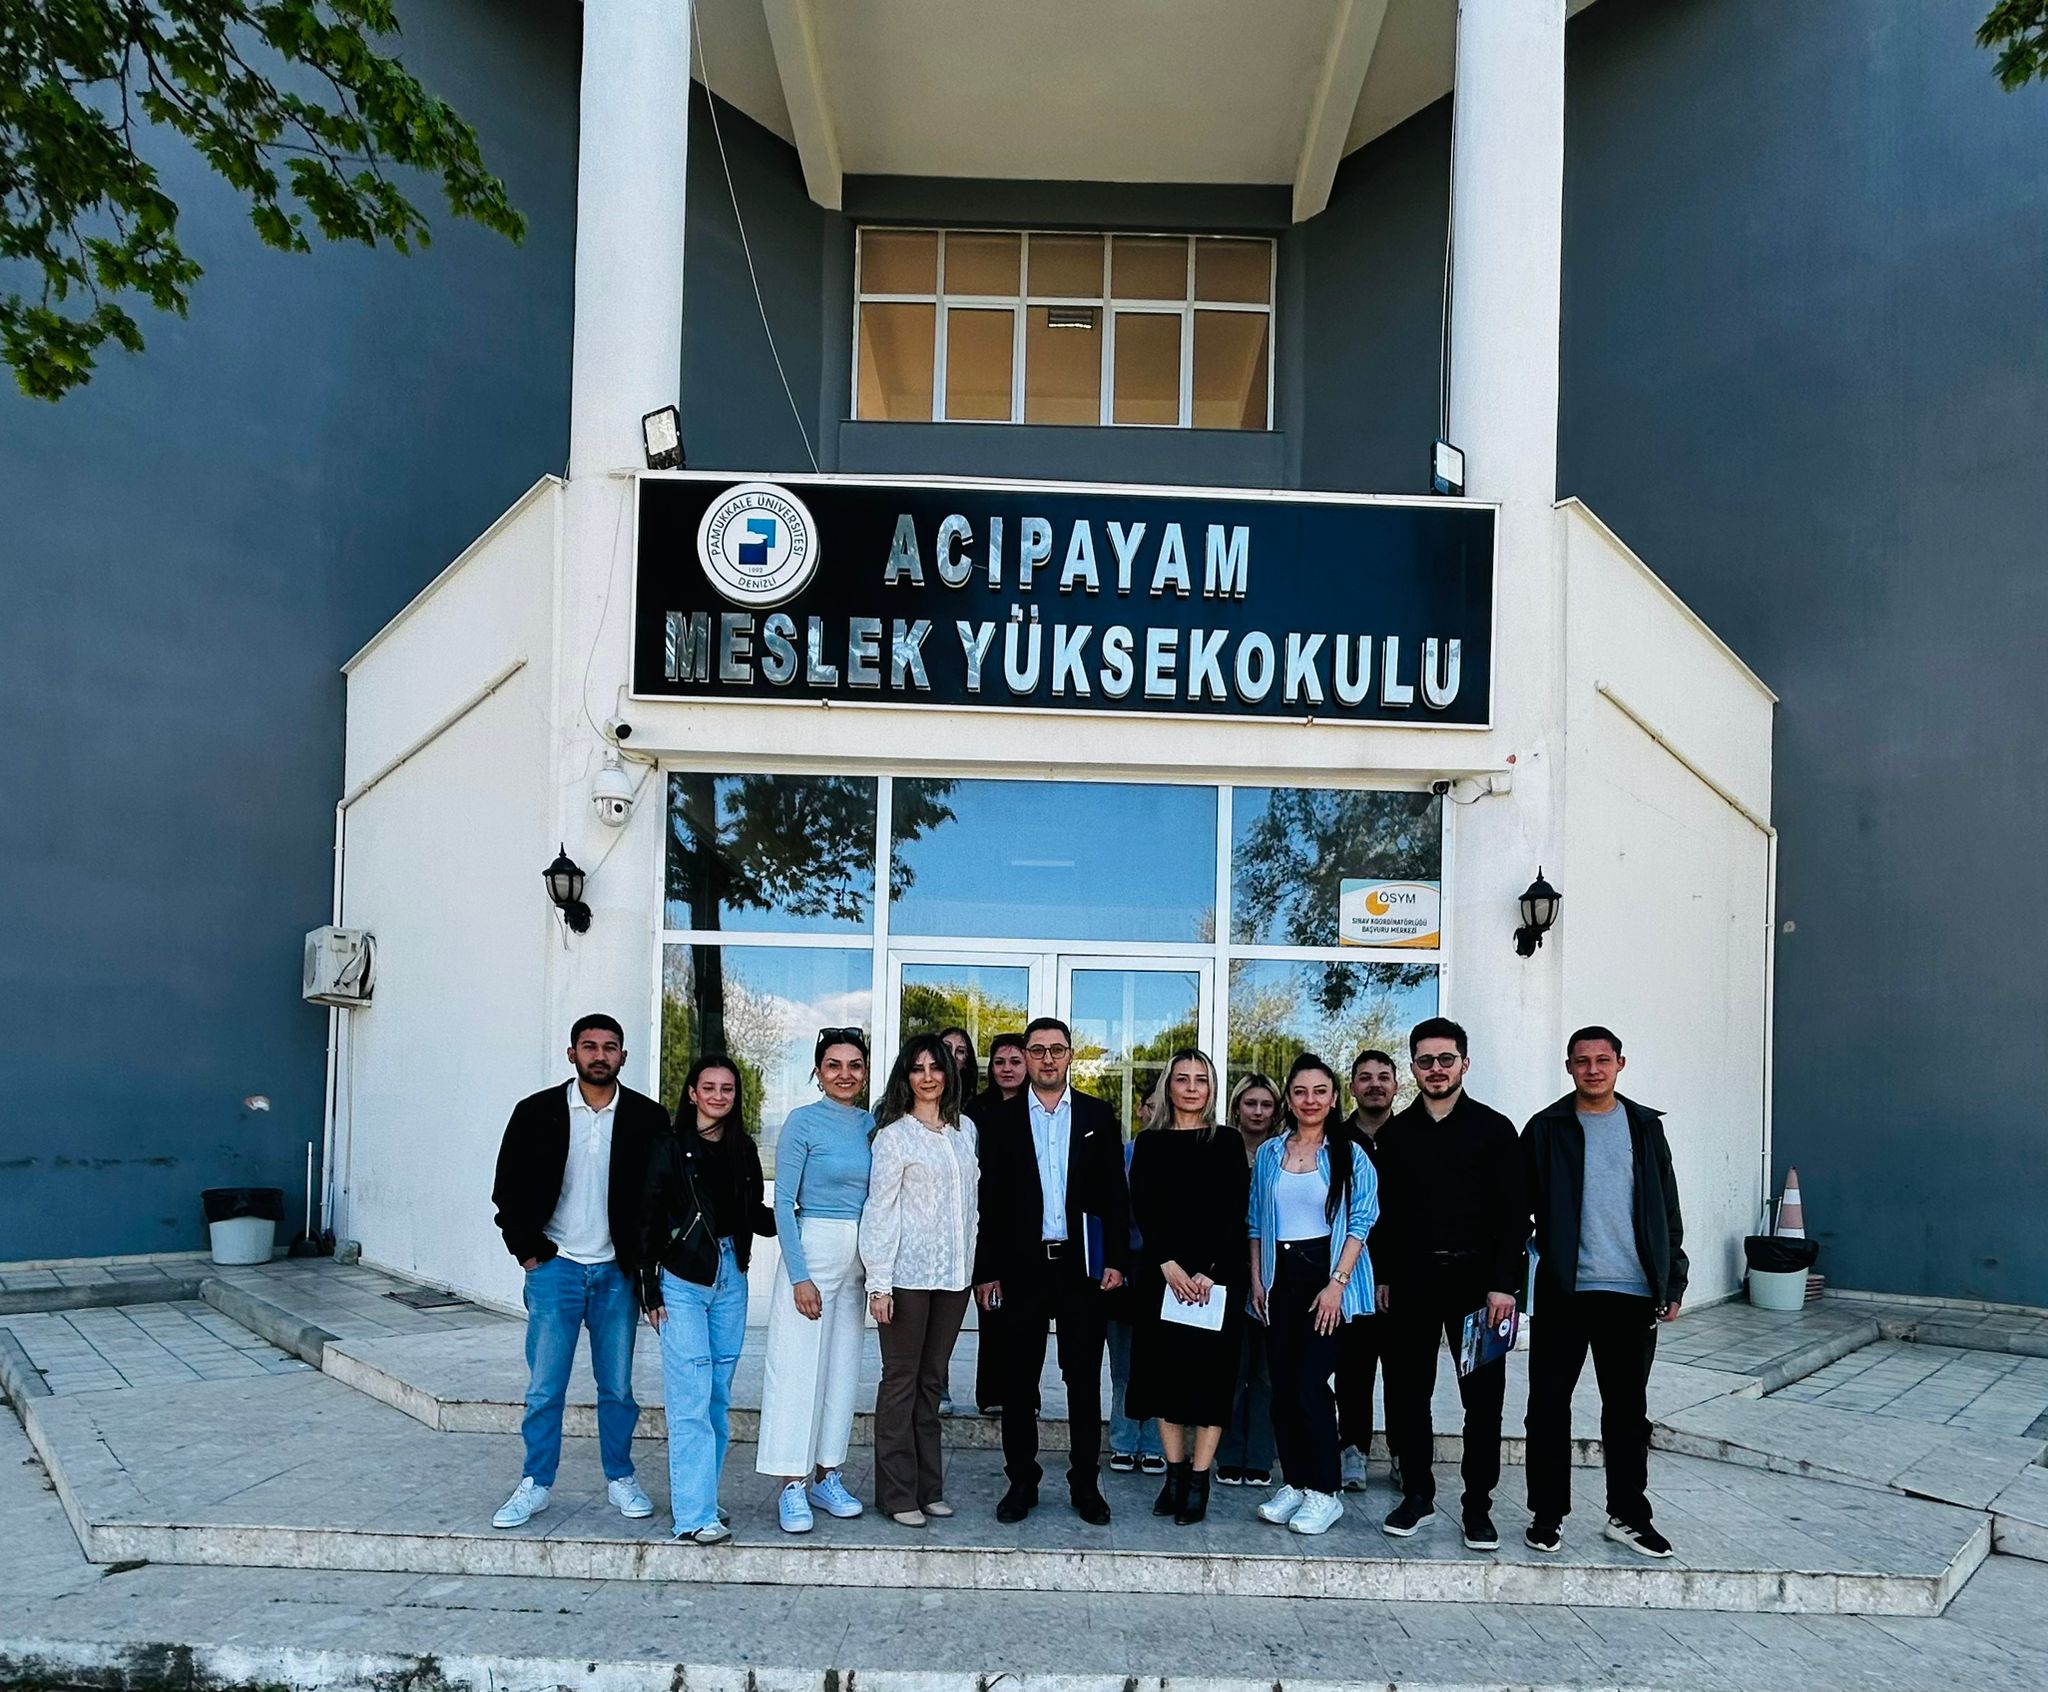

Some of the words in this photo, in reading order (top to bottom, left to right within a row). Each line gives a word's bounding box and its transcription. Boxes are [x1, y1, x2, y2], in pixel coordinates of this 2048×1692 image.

[711, 496, 752, 555] PAMUKKALE
[884, 514, 1250, 598] ACIPAYAM
[664, 610, 932, 690] MESLEK
[956, 604, 1461, 710] YÜKSEKOKULU
